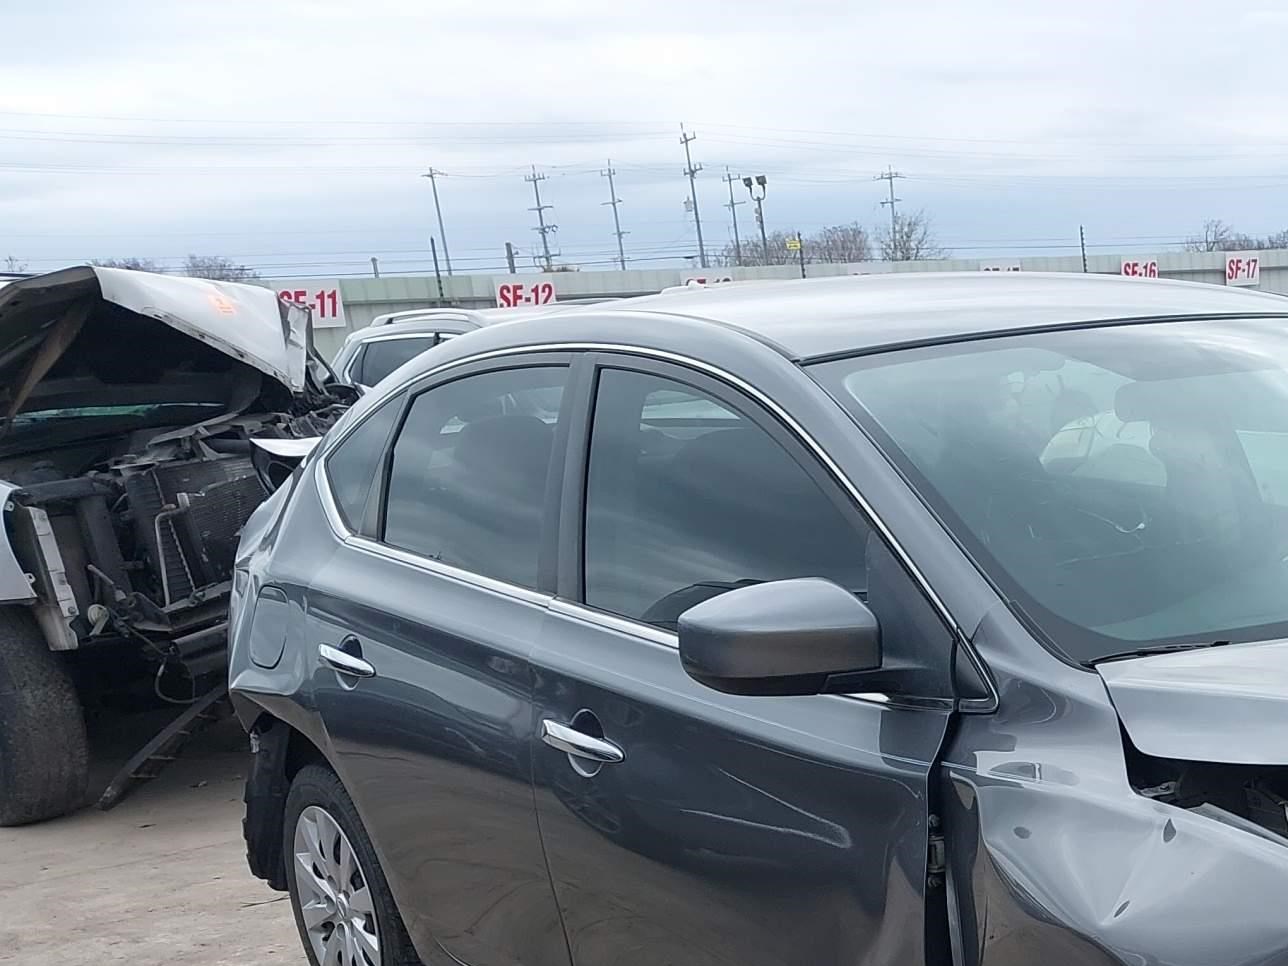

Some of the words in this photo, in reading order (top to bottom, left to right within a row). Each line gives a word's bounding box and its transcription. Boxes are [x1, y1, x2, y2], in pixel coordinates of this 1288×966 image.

[1124, 262, 1157, 278] SF-16
[1227, 259, 1258, 280] SF-17
[499, 283, 554, 308] SF-12
